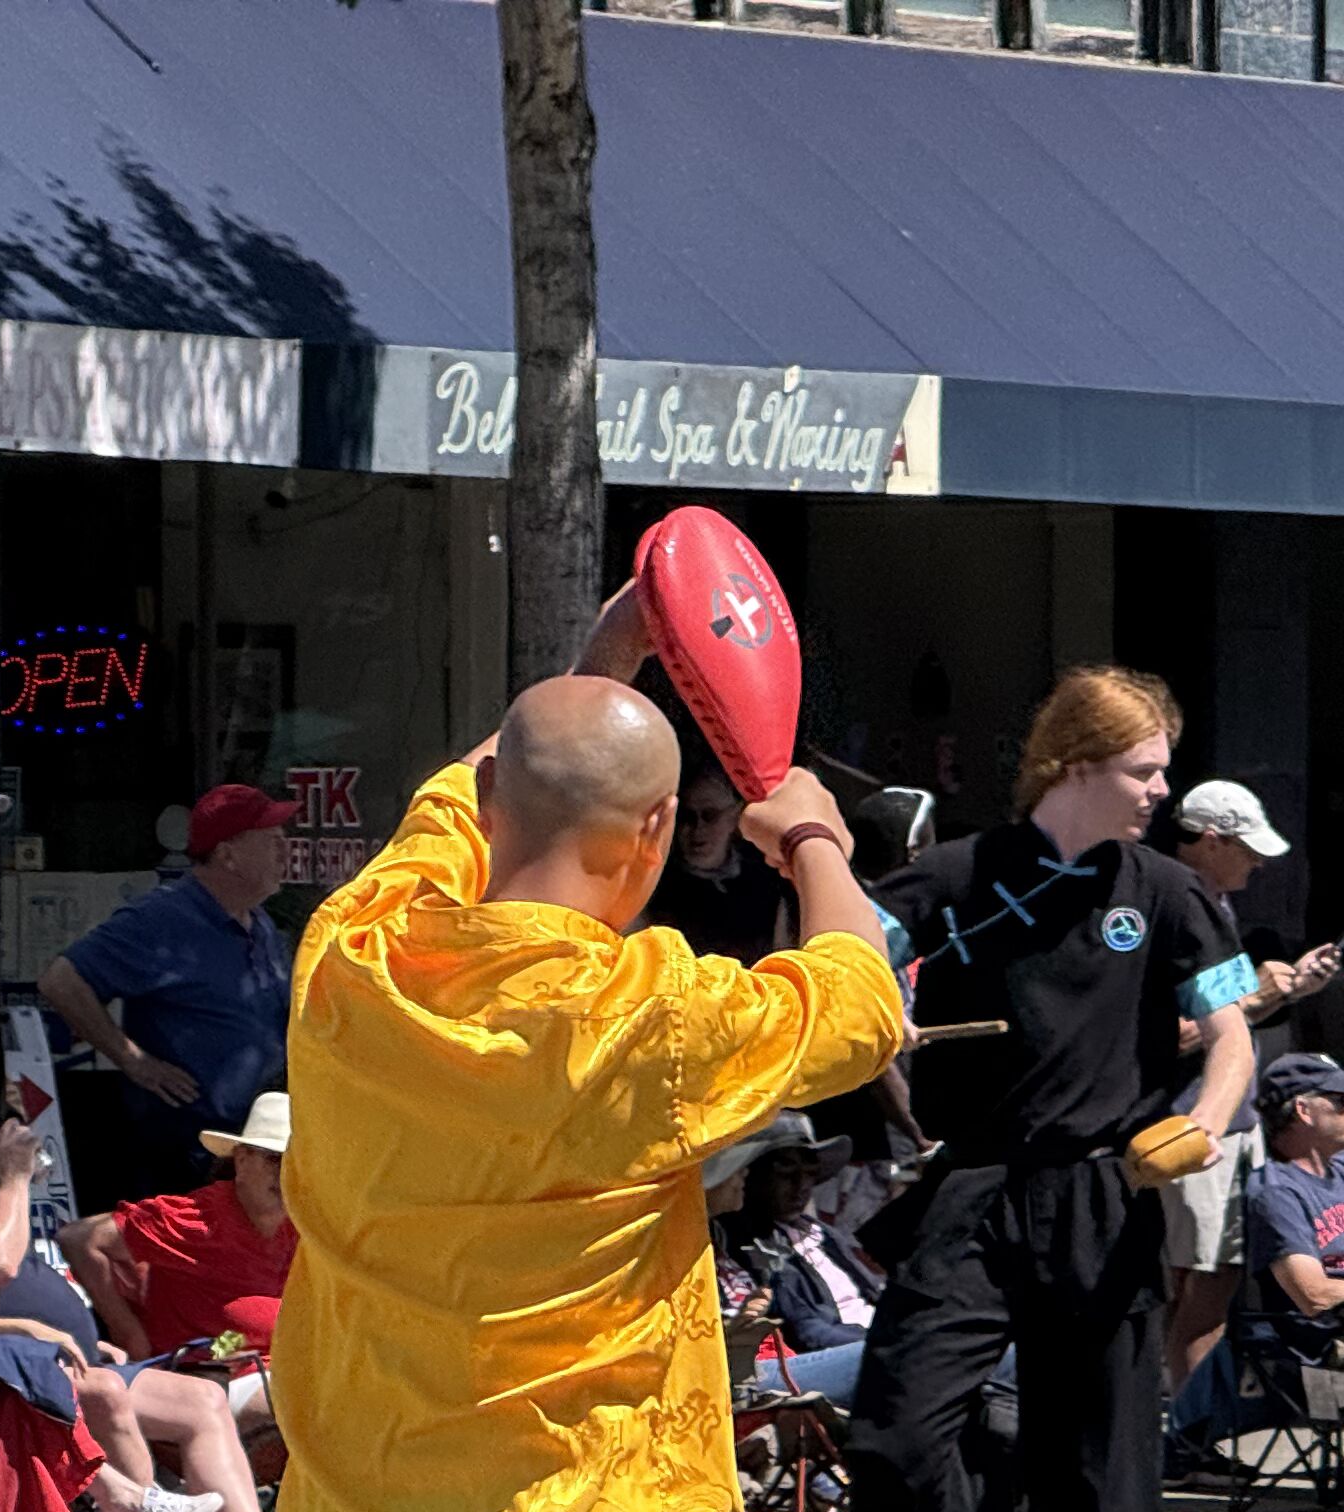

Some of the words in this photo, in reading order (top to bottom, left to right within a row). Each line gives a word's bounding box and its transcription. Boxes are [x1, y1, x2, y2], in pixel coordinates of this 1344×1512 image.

[436, 361, 519, 455] Bel
[595, 372, 649, 463] ail
[650, 386, 716, 481] Spa
[726, 381, 759, 467] &
[760, 388, 887, 492] Waxing
[1, 643, 148, 715] OPEN
[286, 767, 362, 828] TK
